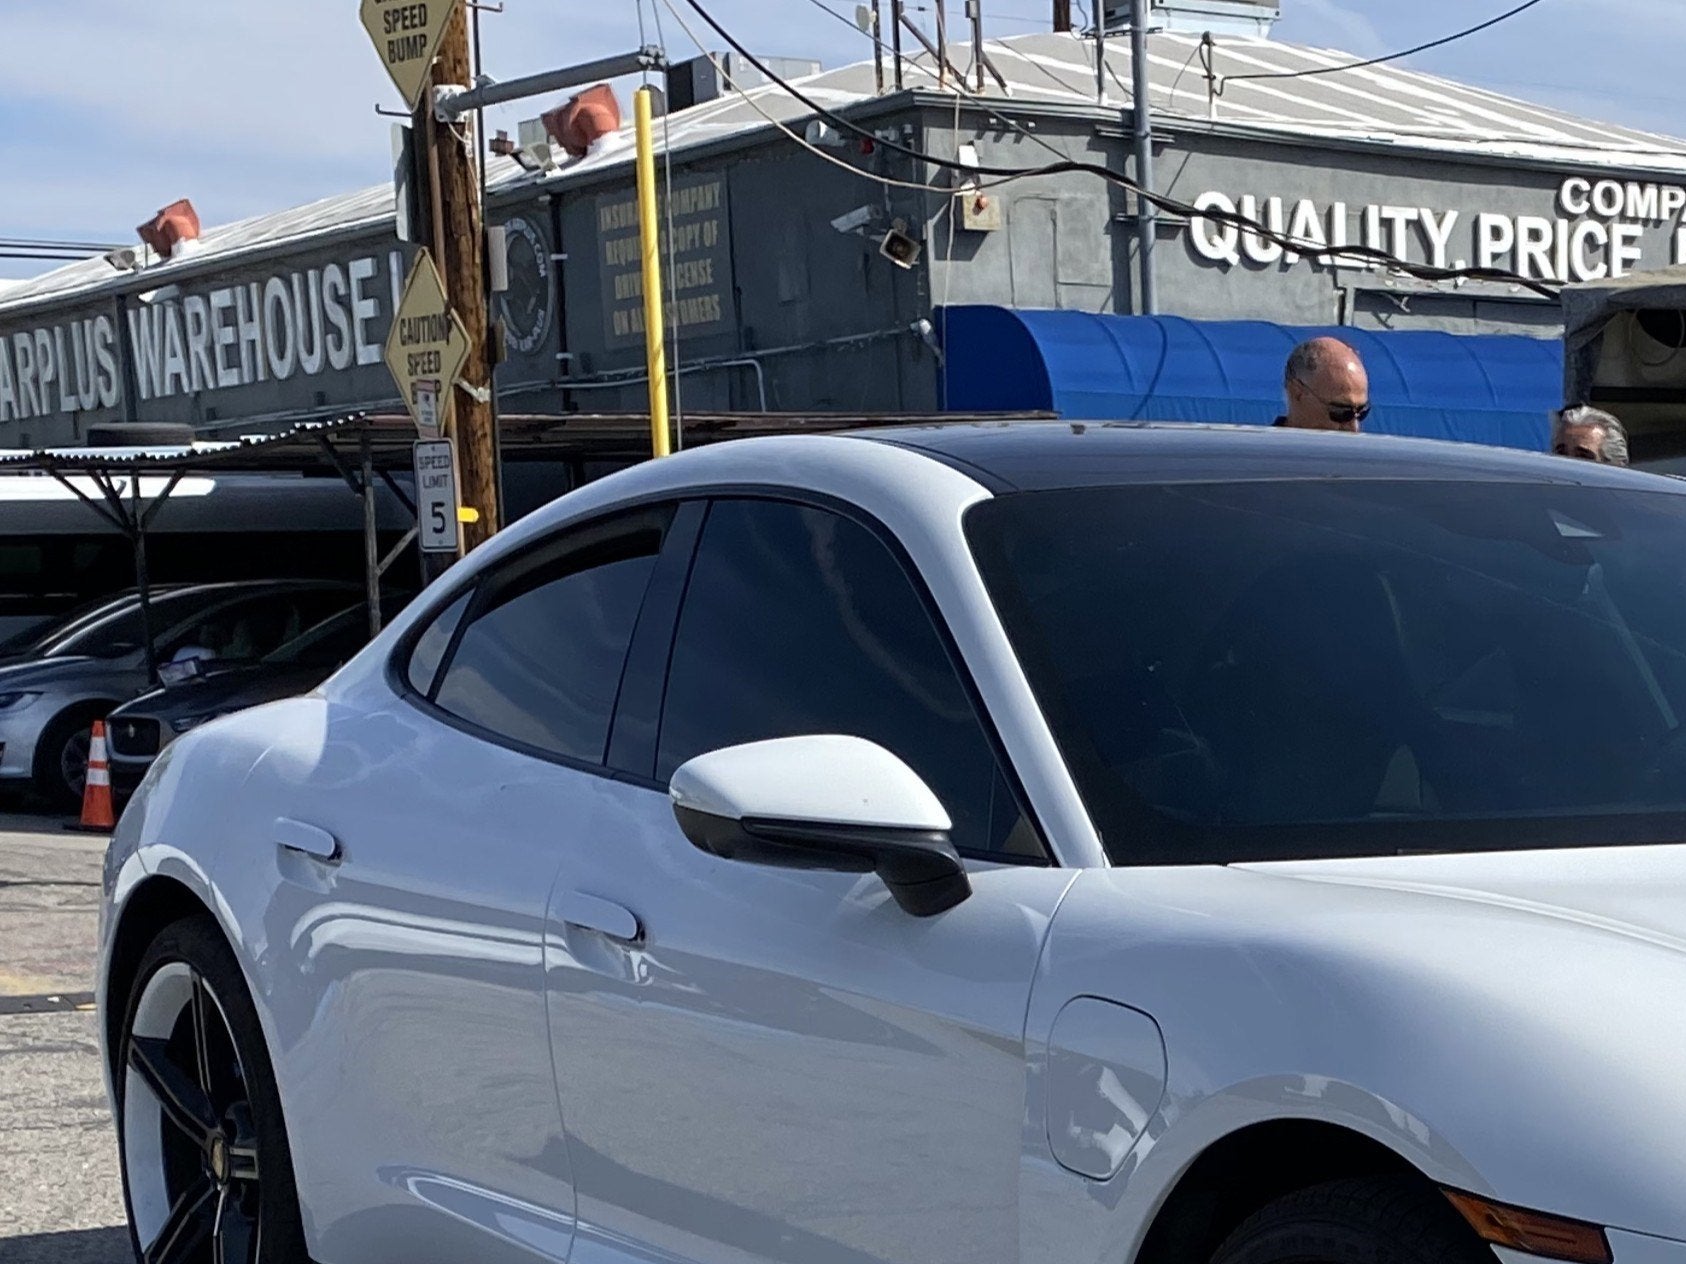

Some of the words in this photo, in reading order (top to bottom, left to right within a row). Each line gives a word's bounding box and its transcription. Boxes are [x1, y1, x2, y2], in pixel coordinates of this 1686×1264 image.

[383, 3, 428, 35] SPEED
[387, 34, 428, 64] BUMP
[1478, 212, 1644, 282] PRICE
[127, 256, 384, 400] WAREHOUSE
[400, 313, 450, 346] CAUTION
[407, 350, 441, 377] SPEED
[418, 454, 450, 470] SPEED
[422, 473, 448, 489] LIMIT
[431, 501, 445, 534] 5
